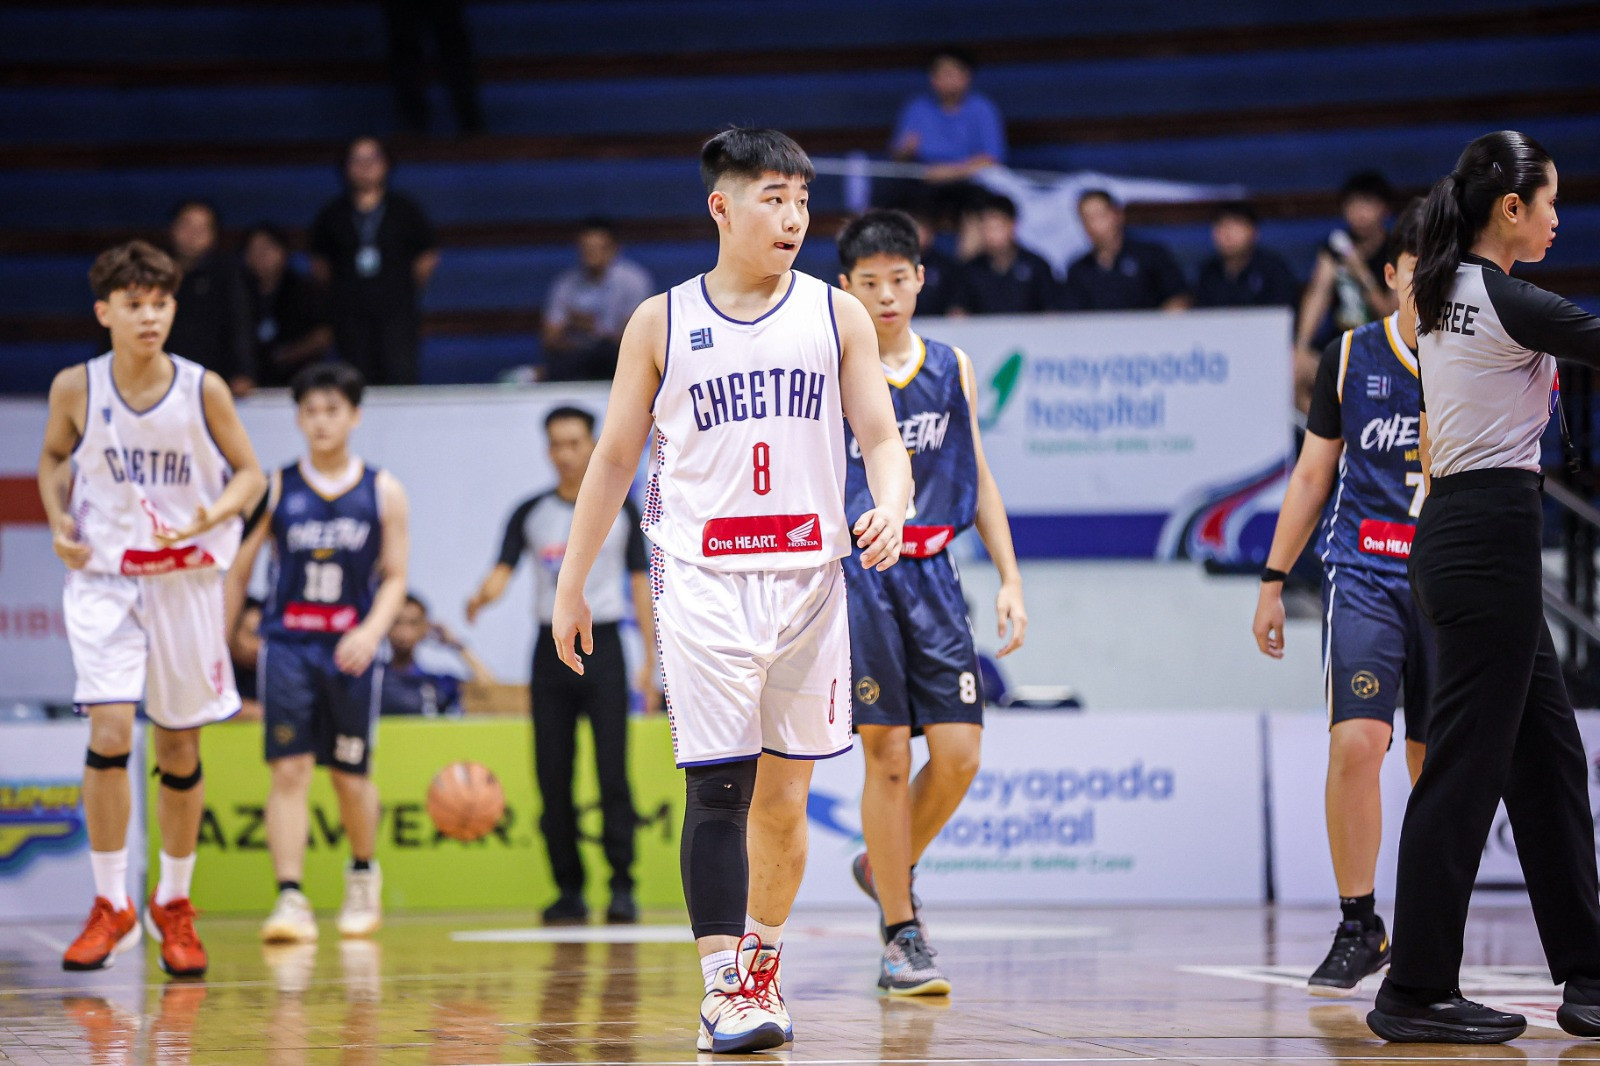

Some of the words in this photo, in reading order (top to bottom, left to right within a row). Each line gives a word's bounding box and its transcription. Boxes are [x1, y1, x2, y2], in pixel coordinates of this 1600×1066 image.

[689, 368, 825, 431] CHEETAH
[753, 442, 772, 496] 8
[1405, 472, 1427, 518] 7
[708, 537, 733, 550] One
[787, 540, 818, 548] HONDA
[1363, 536, 1385, 551] One
[959, 671, 977, 704] 8
[965, 760, 1175, 805] ayapada
[941, 806, 1095, 853] ospital
